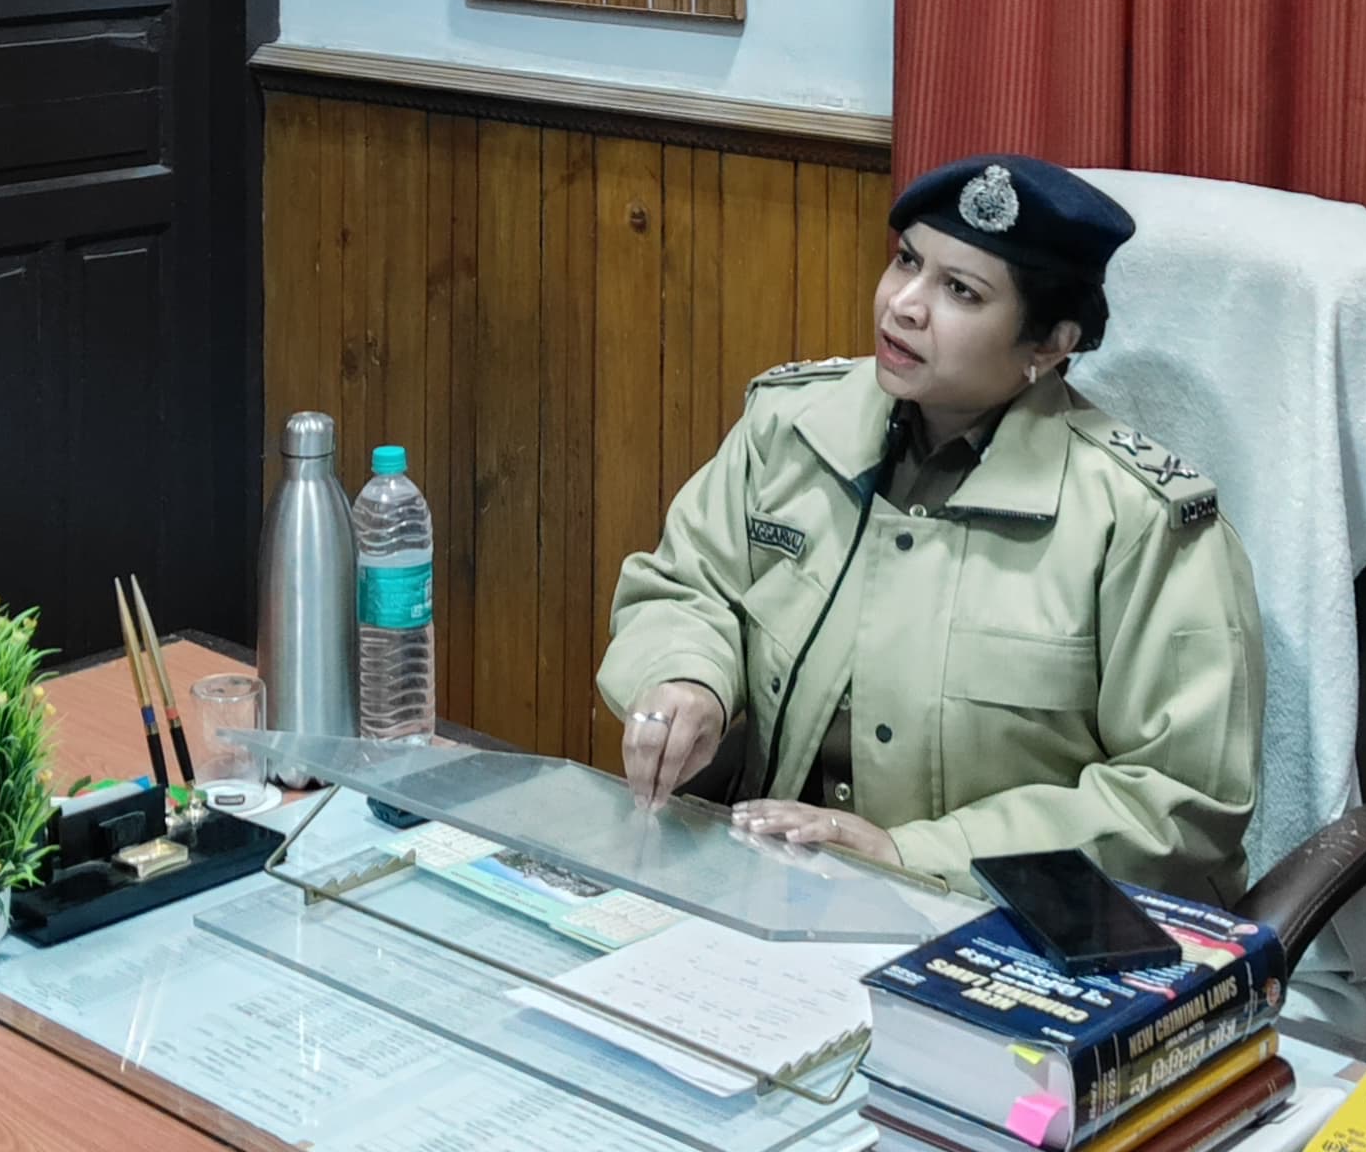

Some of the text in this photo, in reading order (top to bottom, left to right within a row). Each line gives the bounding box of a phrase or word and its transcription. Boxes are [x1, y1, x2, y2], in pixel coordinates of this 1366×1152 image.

[925, 958, 991, 987] LAWS
[960, 987, 1018, 1011] NEW
[986, 980, 1090, 1024] CRIMINAL
[1128, 975, 1237, 1059] NEW CRIMINAL LAWS
